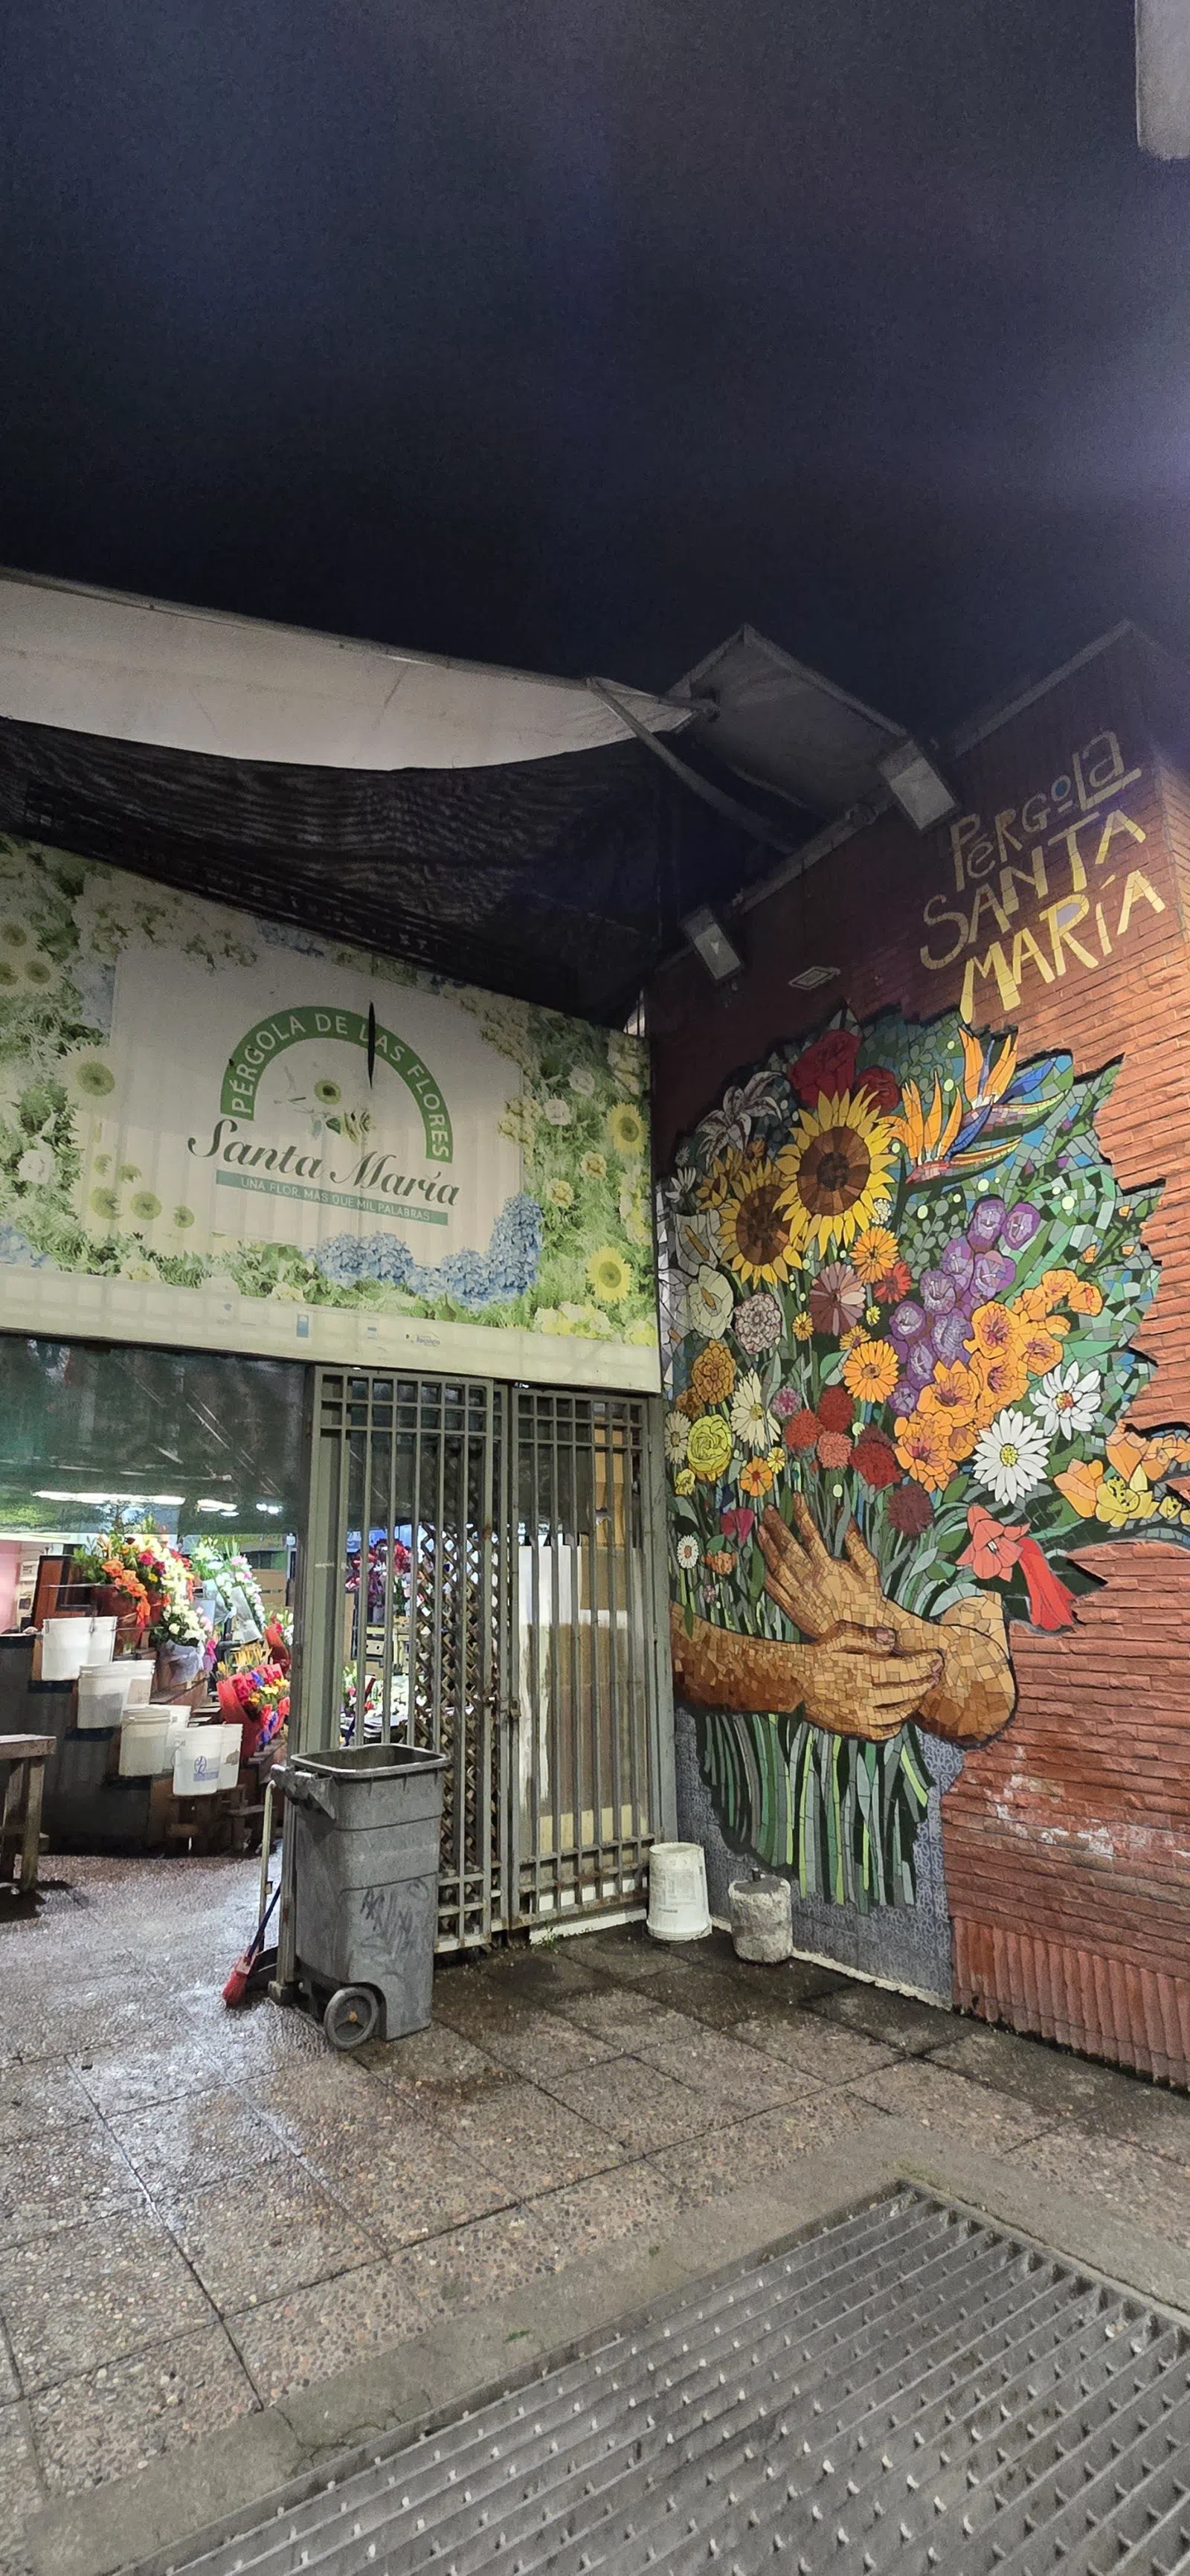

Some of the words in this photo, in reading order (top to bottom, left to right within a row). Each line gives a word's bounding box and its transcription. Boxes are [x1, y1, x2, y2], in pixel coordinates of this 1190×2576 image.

[920, 809, 1147, 969] SANTA
[959, 870, 1166, 1024] MARÍA
[231, 1016, 306, 1114] PÉRGOLA
[315, 1012, 349, 1035] DE
[359, 1023, 405, 1062] LAS
[407, 1064, 449, 1158] FLORES
[187, 1118, 325, 1179] Santa
[329, 1150, 460, 1207] María
[240, 1176, 266, 1192] UNA
[357, 1198, 376, 1212] MIL
[378, 1203, 431, 1221] PALABRAS
